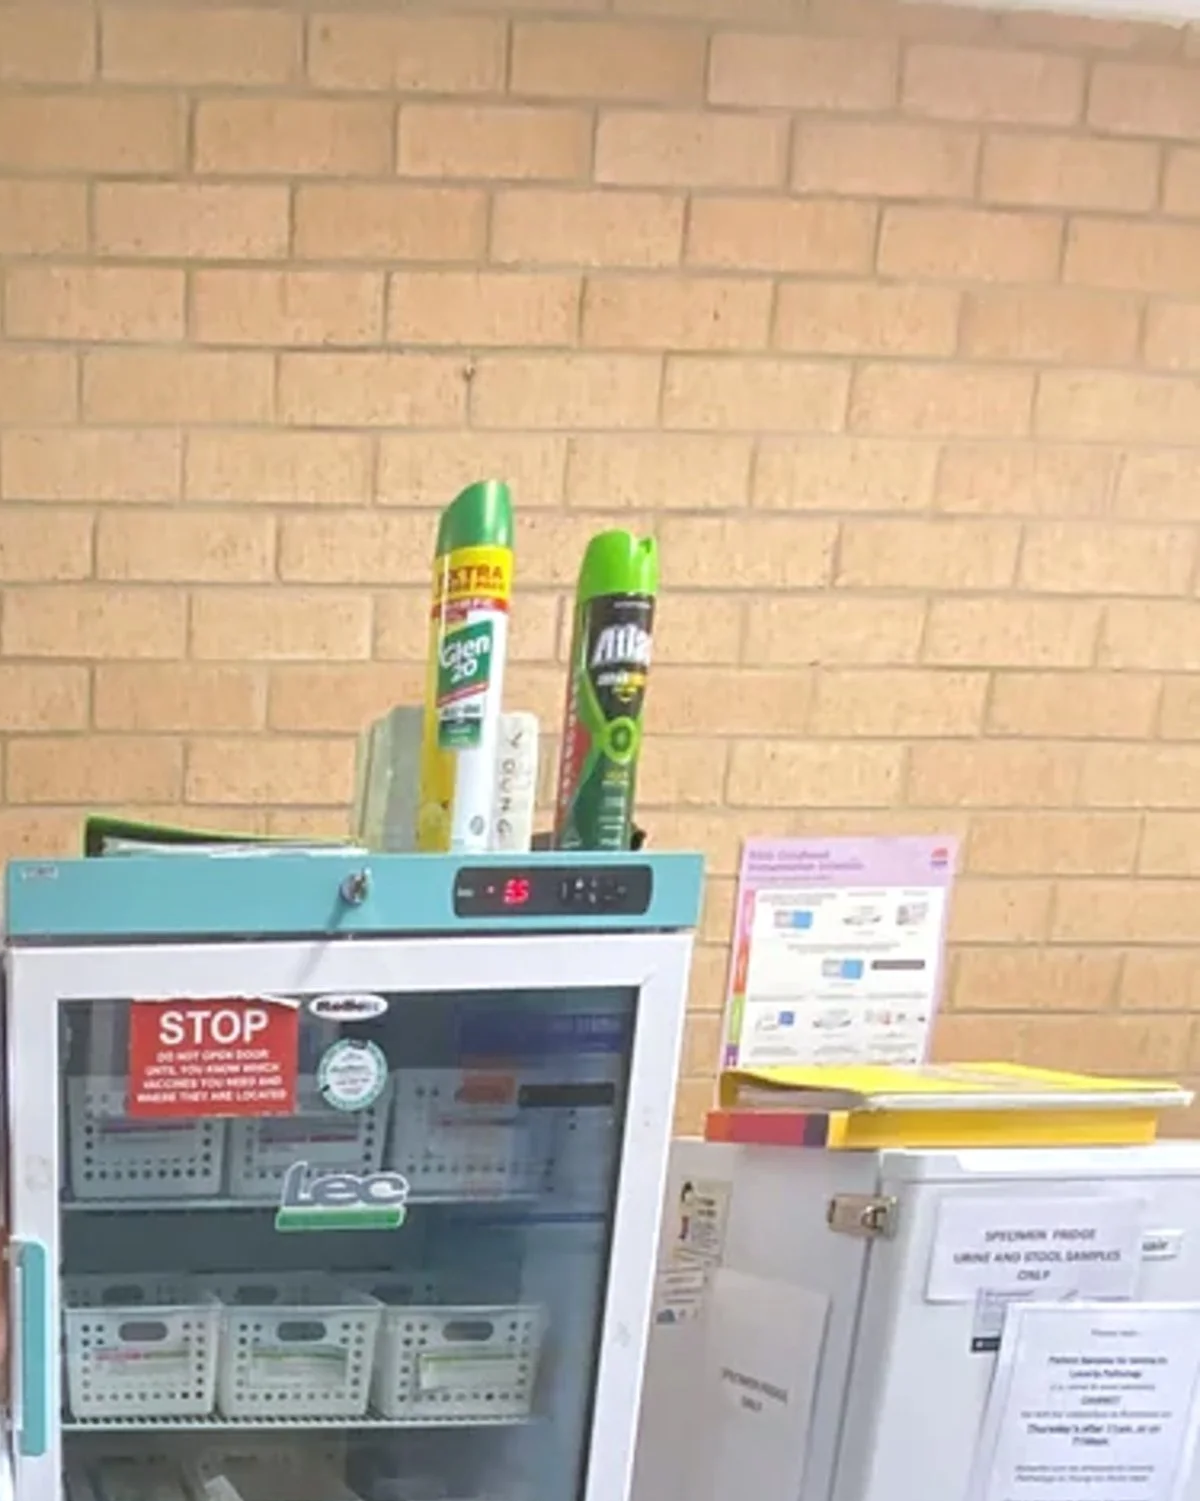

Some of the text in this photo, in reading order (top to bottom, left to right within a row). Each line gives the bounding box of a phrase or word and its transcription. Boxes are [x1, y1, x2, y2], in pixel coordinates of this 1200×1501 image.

[440, 635, 491, 668] Glen
[450, 659, 479, 684] 20
[158, 1009, 270, 1046] STOP
[156, 1048, 270, 1063] DO NOT OPEN DOOR
[180, 1064, 202, 1075] YOU
[206, 1063, 241, 1074] KNOW
[243, 1062, 281, 1073] WHICH
[201, 1077, 224, 1089] YOU
[258, 1075, 283, 1086] AND
[179, 1090, 208, 1102] THEY
[210, 1089, 233, 1101] ARE
[236, 1088, 288, 1101] LOCATED
[282, 1160, 410, 1207] Lec
[984, 1228, 1097, 1243] SPECIMEN FRIDGE
[952, 1249, 1122, 1264] URINE AND STOOL SAMPLES
[1016, 1269, 1051, 1281] ONLY
